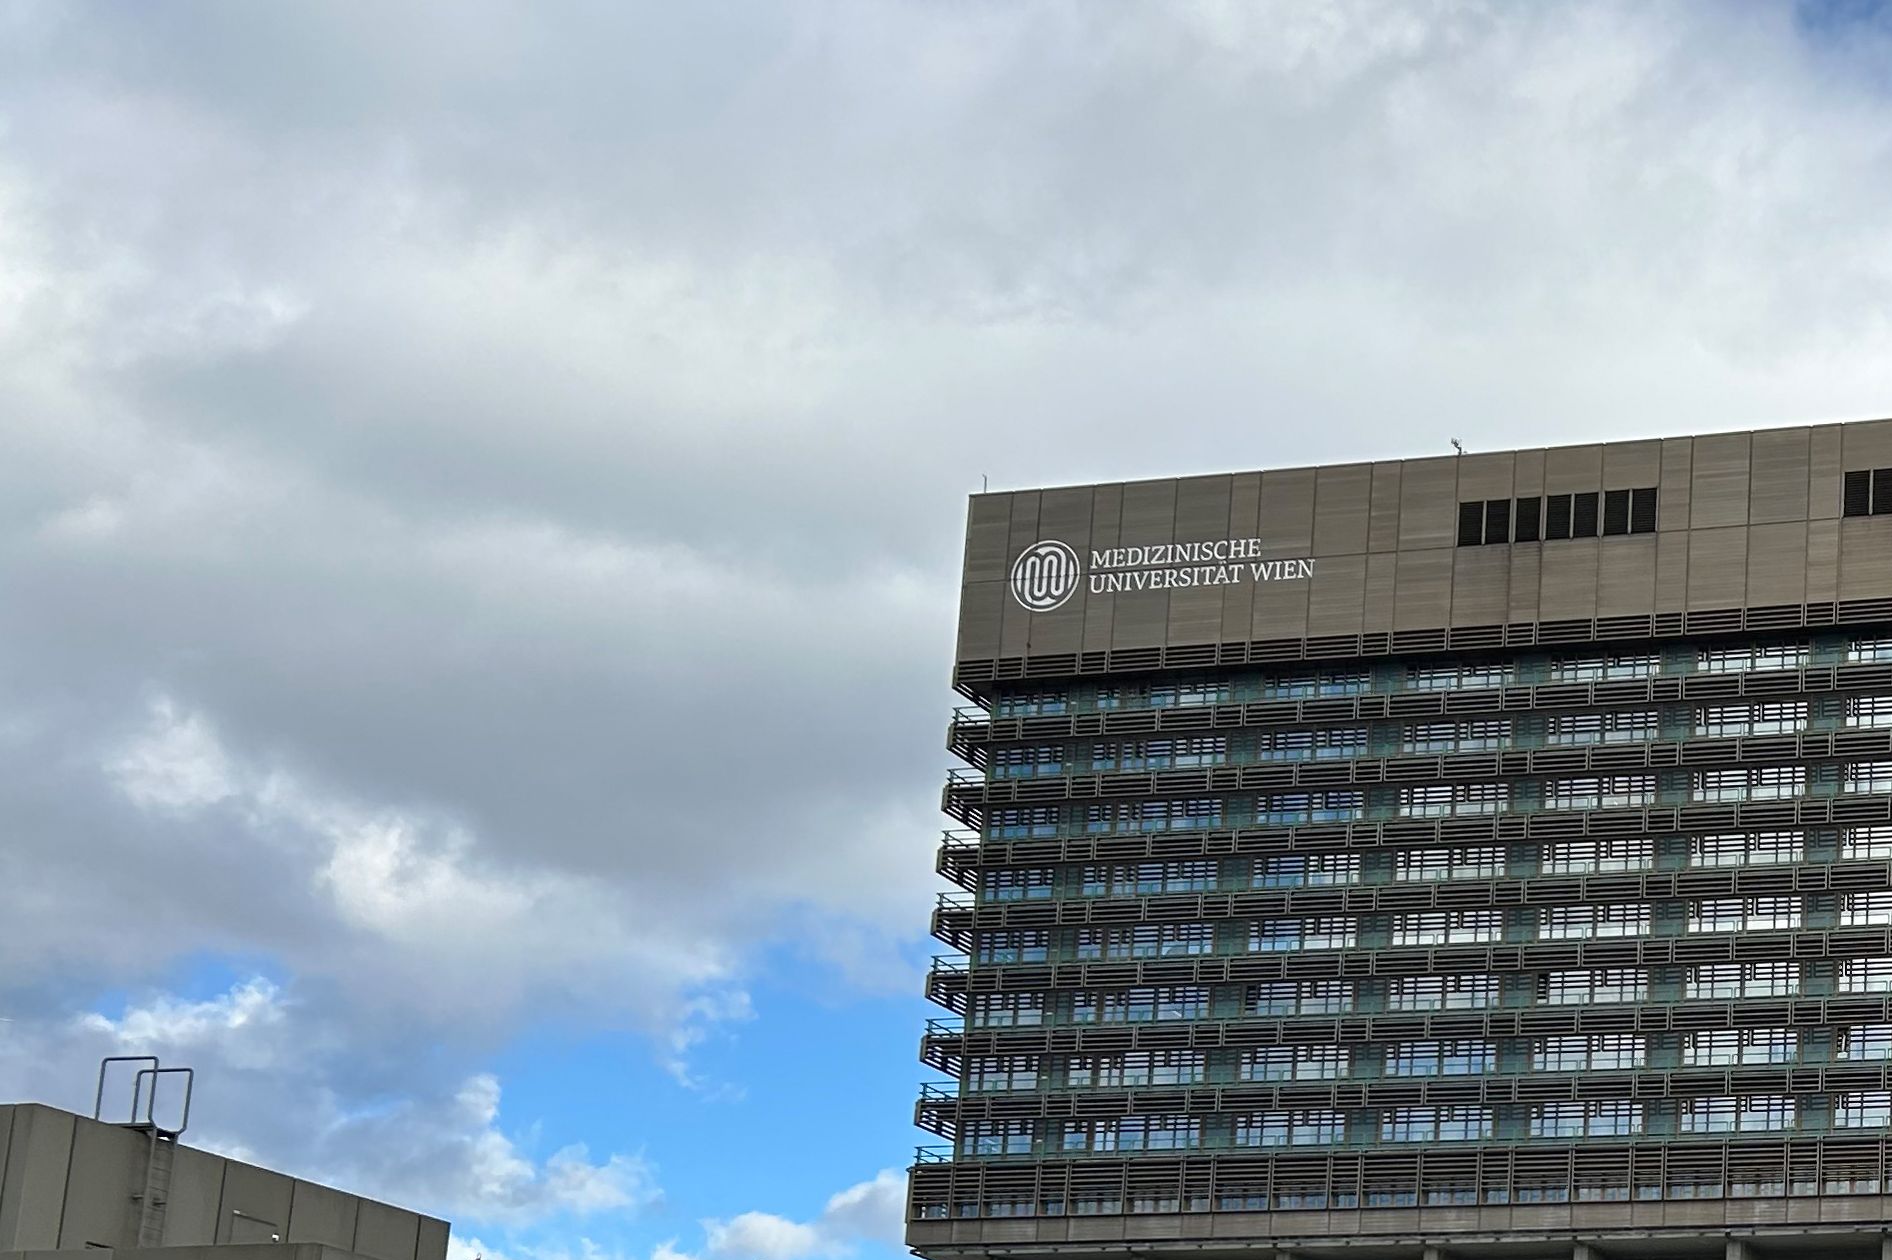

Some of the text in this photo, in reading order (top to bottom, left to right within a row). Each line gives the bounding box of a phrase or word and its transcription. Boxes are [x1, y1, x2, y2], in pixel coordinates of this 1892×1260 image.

[1089, 538, 1262, 569] MEDIZINISCHE
[1089, 559, 1316, 594] UNIVERSITÄT WIEN
